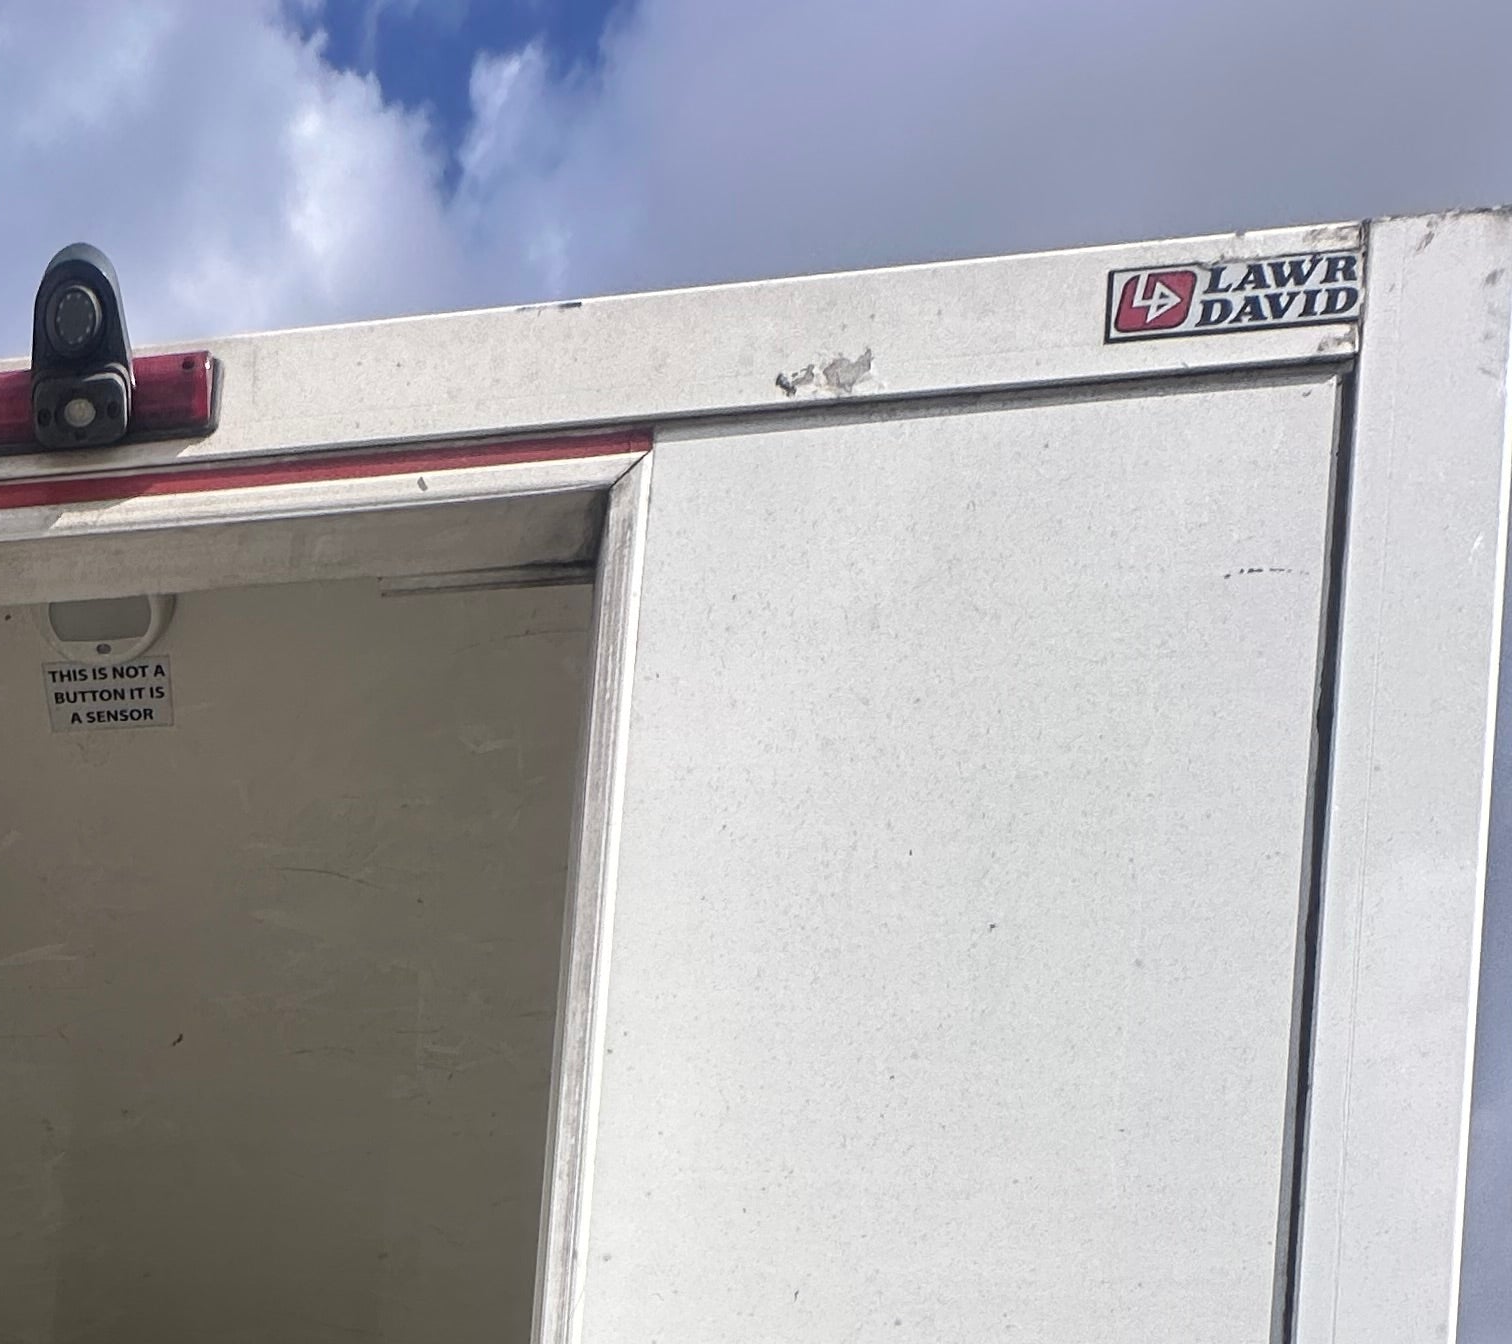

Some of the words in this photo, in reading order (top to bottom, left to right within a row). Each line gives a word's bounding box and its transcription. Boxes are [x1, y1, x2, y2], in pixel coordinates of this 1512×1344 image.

[1203, 254, 1358, 294] LAWR
[1195, 286, 1359, 328] DAVID
[48, 668, 88, 683] THIS
[92, 666, 108, 681] IS
[112, 665, 149, 680] NOT
[153, 664, 166, 678] A
[54, 688, 126, 705] BUTTON
[129, 686, 146, 701] IT
[149, 686, 165, 700] IS
[71, 711, 83, 725] A
[86, 708, 154, 724] SENSOR
